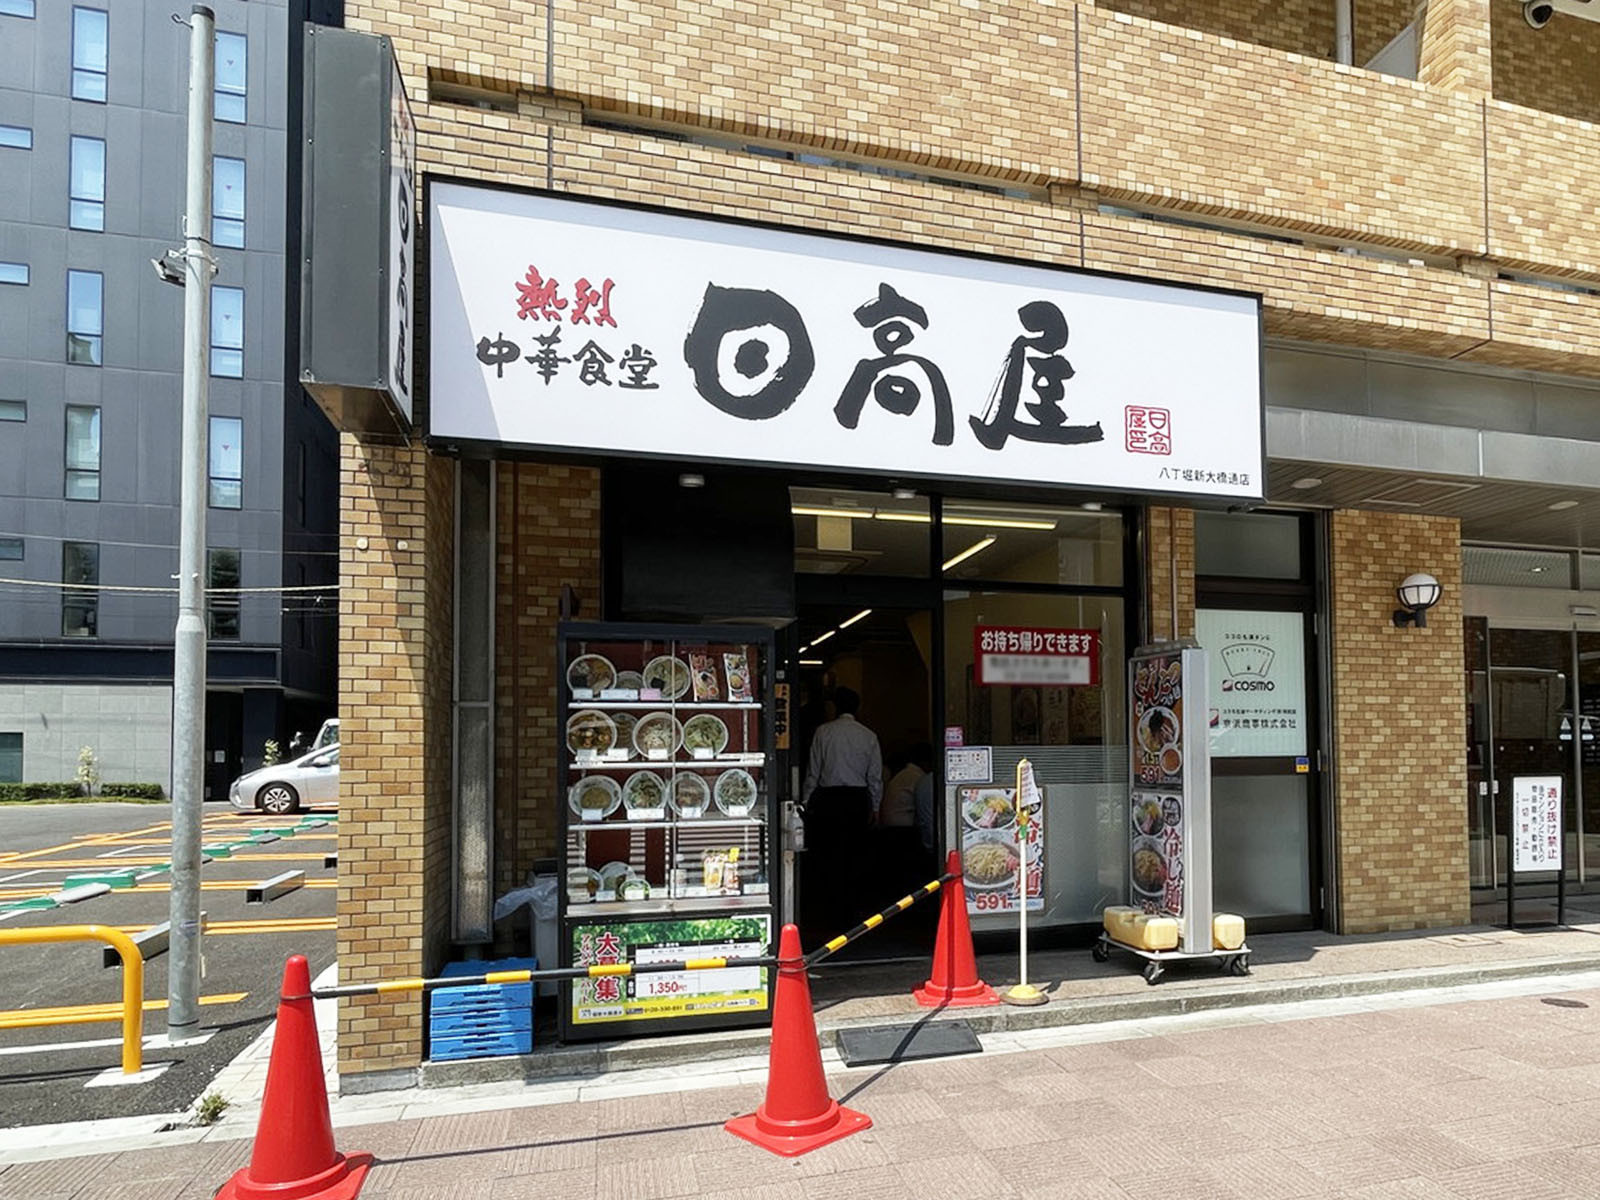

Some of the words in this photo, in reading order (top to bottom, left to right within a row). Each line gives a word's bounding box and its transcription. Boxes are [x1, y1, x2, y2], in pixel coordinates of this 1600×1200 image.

[515, 265, 617, 328] 熱烈
[476, 326, 660, 389] 中華食堂
[684, 281, 1104, 449] 日高屋
[1159, 467, 1250, 486] 八丁堀新大橋通店
[981, 630, 1092, 653] お持ち帰りできます
[1547, 786, 1558, 860] 通り抜け禁止
